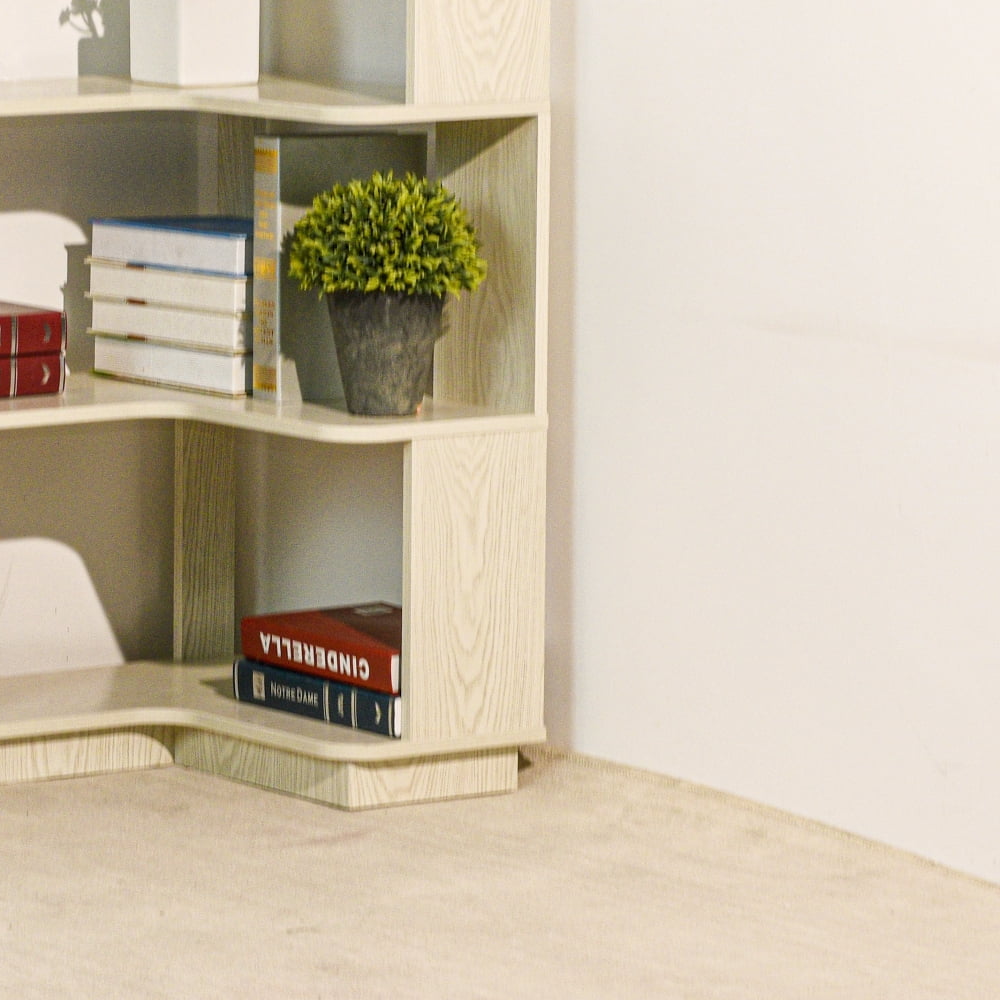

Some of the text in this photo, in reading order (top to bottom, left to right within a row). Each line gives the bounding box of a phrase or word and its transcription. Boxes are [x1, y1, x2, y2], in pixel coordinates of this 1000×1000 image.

[259, 631, 370, 681] CINDERELLA
[270, 681, 296, 703] NOTRE
[296, 687, 319, 707] DAME
